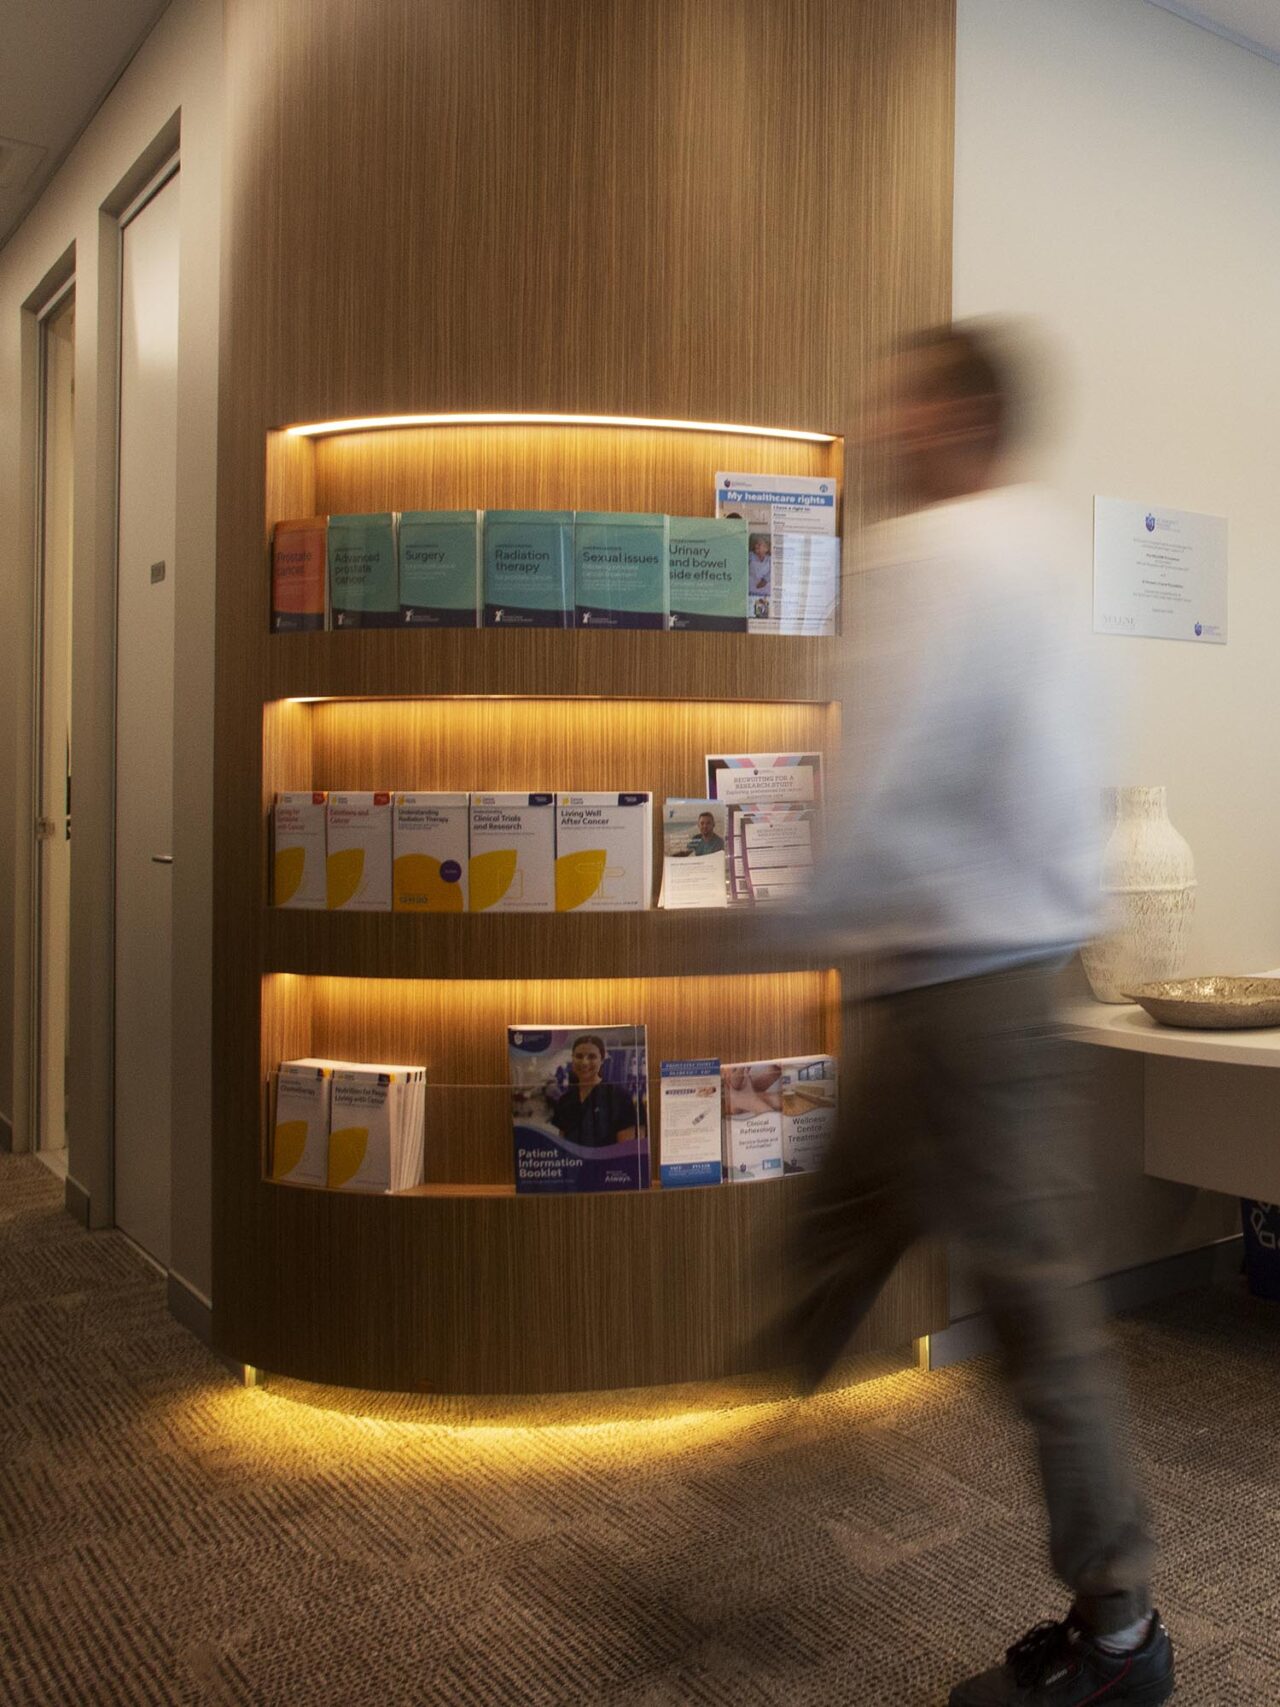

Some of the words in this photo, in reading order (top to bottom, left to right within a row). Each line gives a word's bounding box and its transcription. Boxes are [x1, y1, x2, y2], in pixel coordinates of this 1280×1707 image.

[727, 491, 743, 502] My
[744, 492, 795, 503] healthcare
[797, 494, 826, 505] rights
[495, 548, 550, 561] Radiation
[669, 544, 710, 557] Urinary
[334, 552, 380, 563] Advanced
[405, 550, 446, 562] Surgery
[582, 551, 623, 563] Sexual
[624, 552, 659, 564] issues
[496, 562, 541, 574] therapy
[669, 558, 689, 568] and
[693, 558, 727, 569] bowel
[335, 564, 372, 576] prostate
[669, 569, 691, 580] side
[693, 569, 732, 581] effects
[335, 576, 368, 586] cancer
[561, 810, 584, 818] Living
[585, 809, 602, 817] Well
[426, 816, 449, 824] Therapy
[746, 1119, 770, 1128] Clinical
[792, 1115, 826, 1125] Wellness
[739, 1126, 777, 1135] Reflexology
[796, 1124, 822, 1133] Centre
[518, 1148, 559, 1158] Patient
[518, 1158, 583, 1168] Information
[519, 1168, 562, 1178] Booklet
